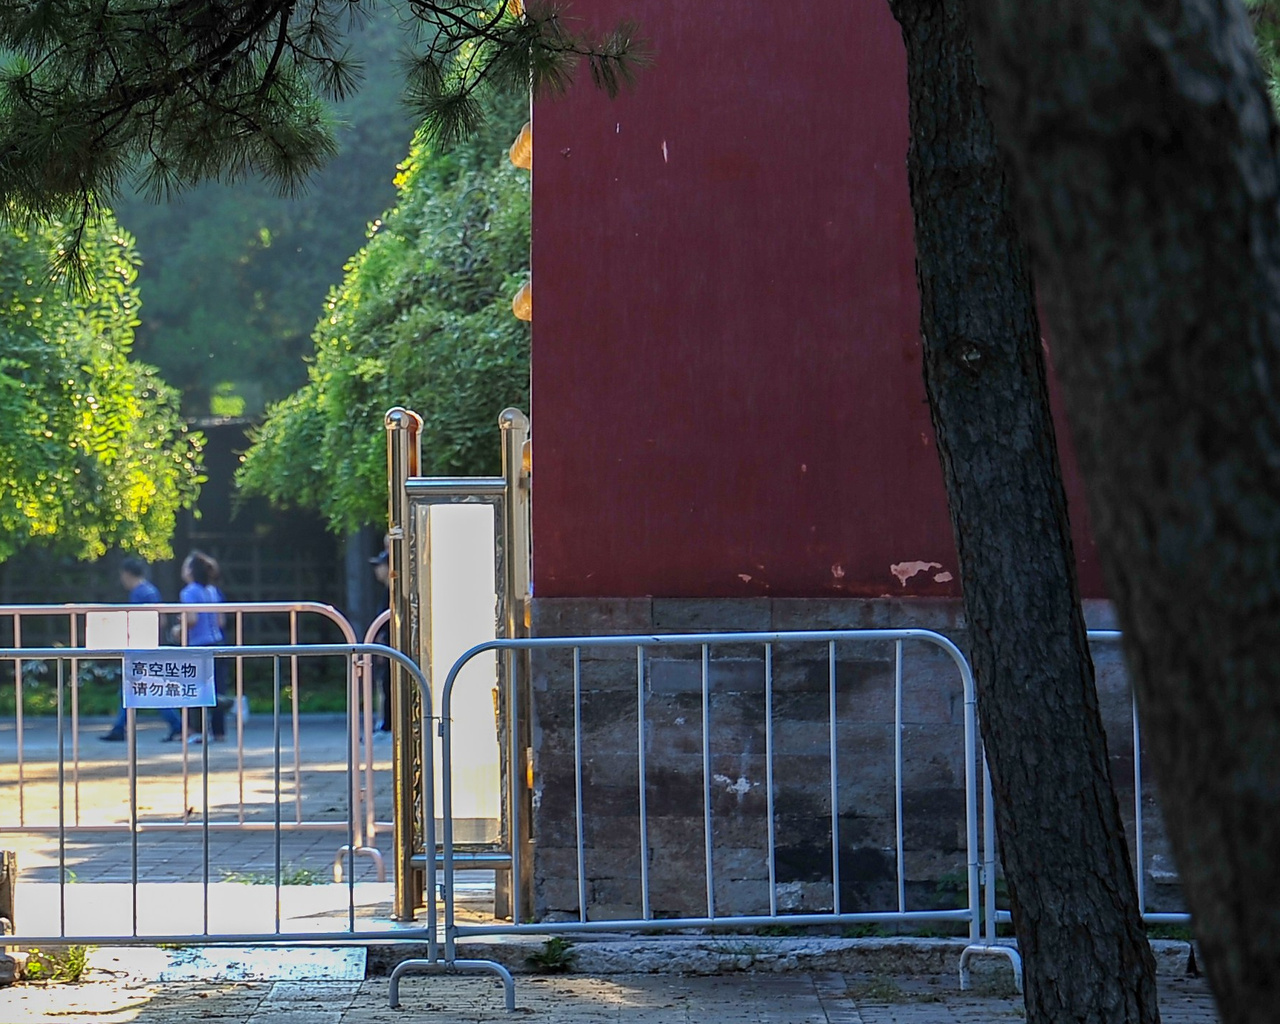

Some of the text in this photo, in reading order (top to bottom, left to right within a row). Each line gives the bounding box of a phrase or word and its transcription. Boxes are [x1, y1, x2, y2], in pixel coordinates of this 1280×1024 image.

[132, 661, 197, 678] 高空坠物
[132, 682, 198, 697] 请勿靠近
